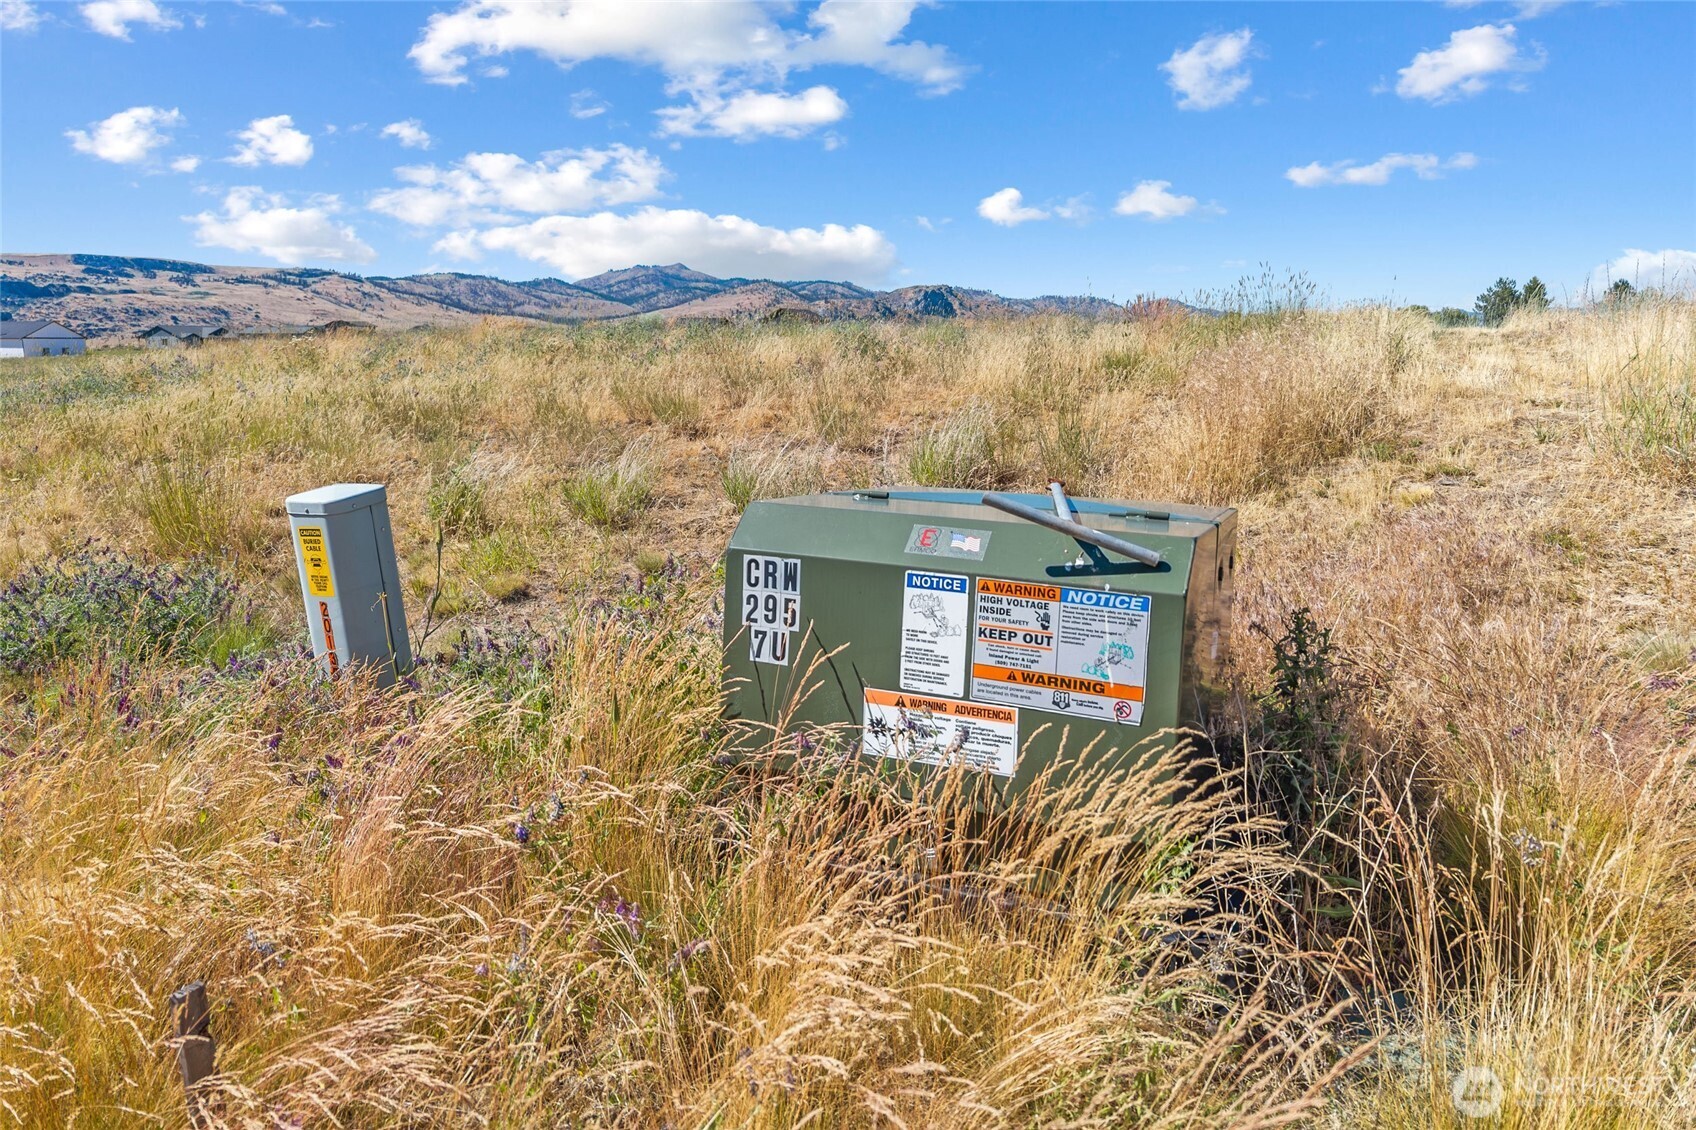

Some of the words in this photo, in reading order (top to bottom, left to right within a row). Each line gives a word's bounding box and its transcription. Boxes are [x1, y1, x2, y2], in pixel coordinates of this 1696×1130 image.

[746, 558, 798, 592] CRW
[912, 575, 961, 590] NOTICE
[994, 582, 1056, 599] WARNING
[980, 595, 1003, 605] HIGH
[1007, 598, 1050, 610] VOLTAGE
[1067, 590, 1144, 610] NOTICE
[745, 594, 797, 628] 295
[979, 605, 1012, 616] INSIDE
[1008, 618, 1029, 626] SAFETY
[754, 629, 786, 662] 7U
[978, 627, 1018, 642] KEEP
[1023, 633, 1053, 647] OUT
[977, 682, 1008, 691] Underground
[1026, 688, 1041, 696] cables
[1021, 672, 1105, 694] WARNING
[1053, 691, 1069, 704] 811
[909, 698, 947, 712] WARNING
[955, 704, 1012, 721] ADVERTENCIA
